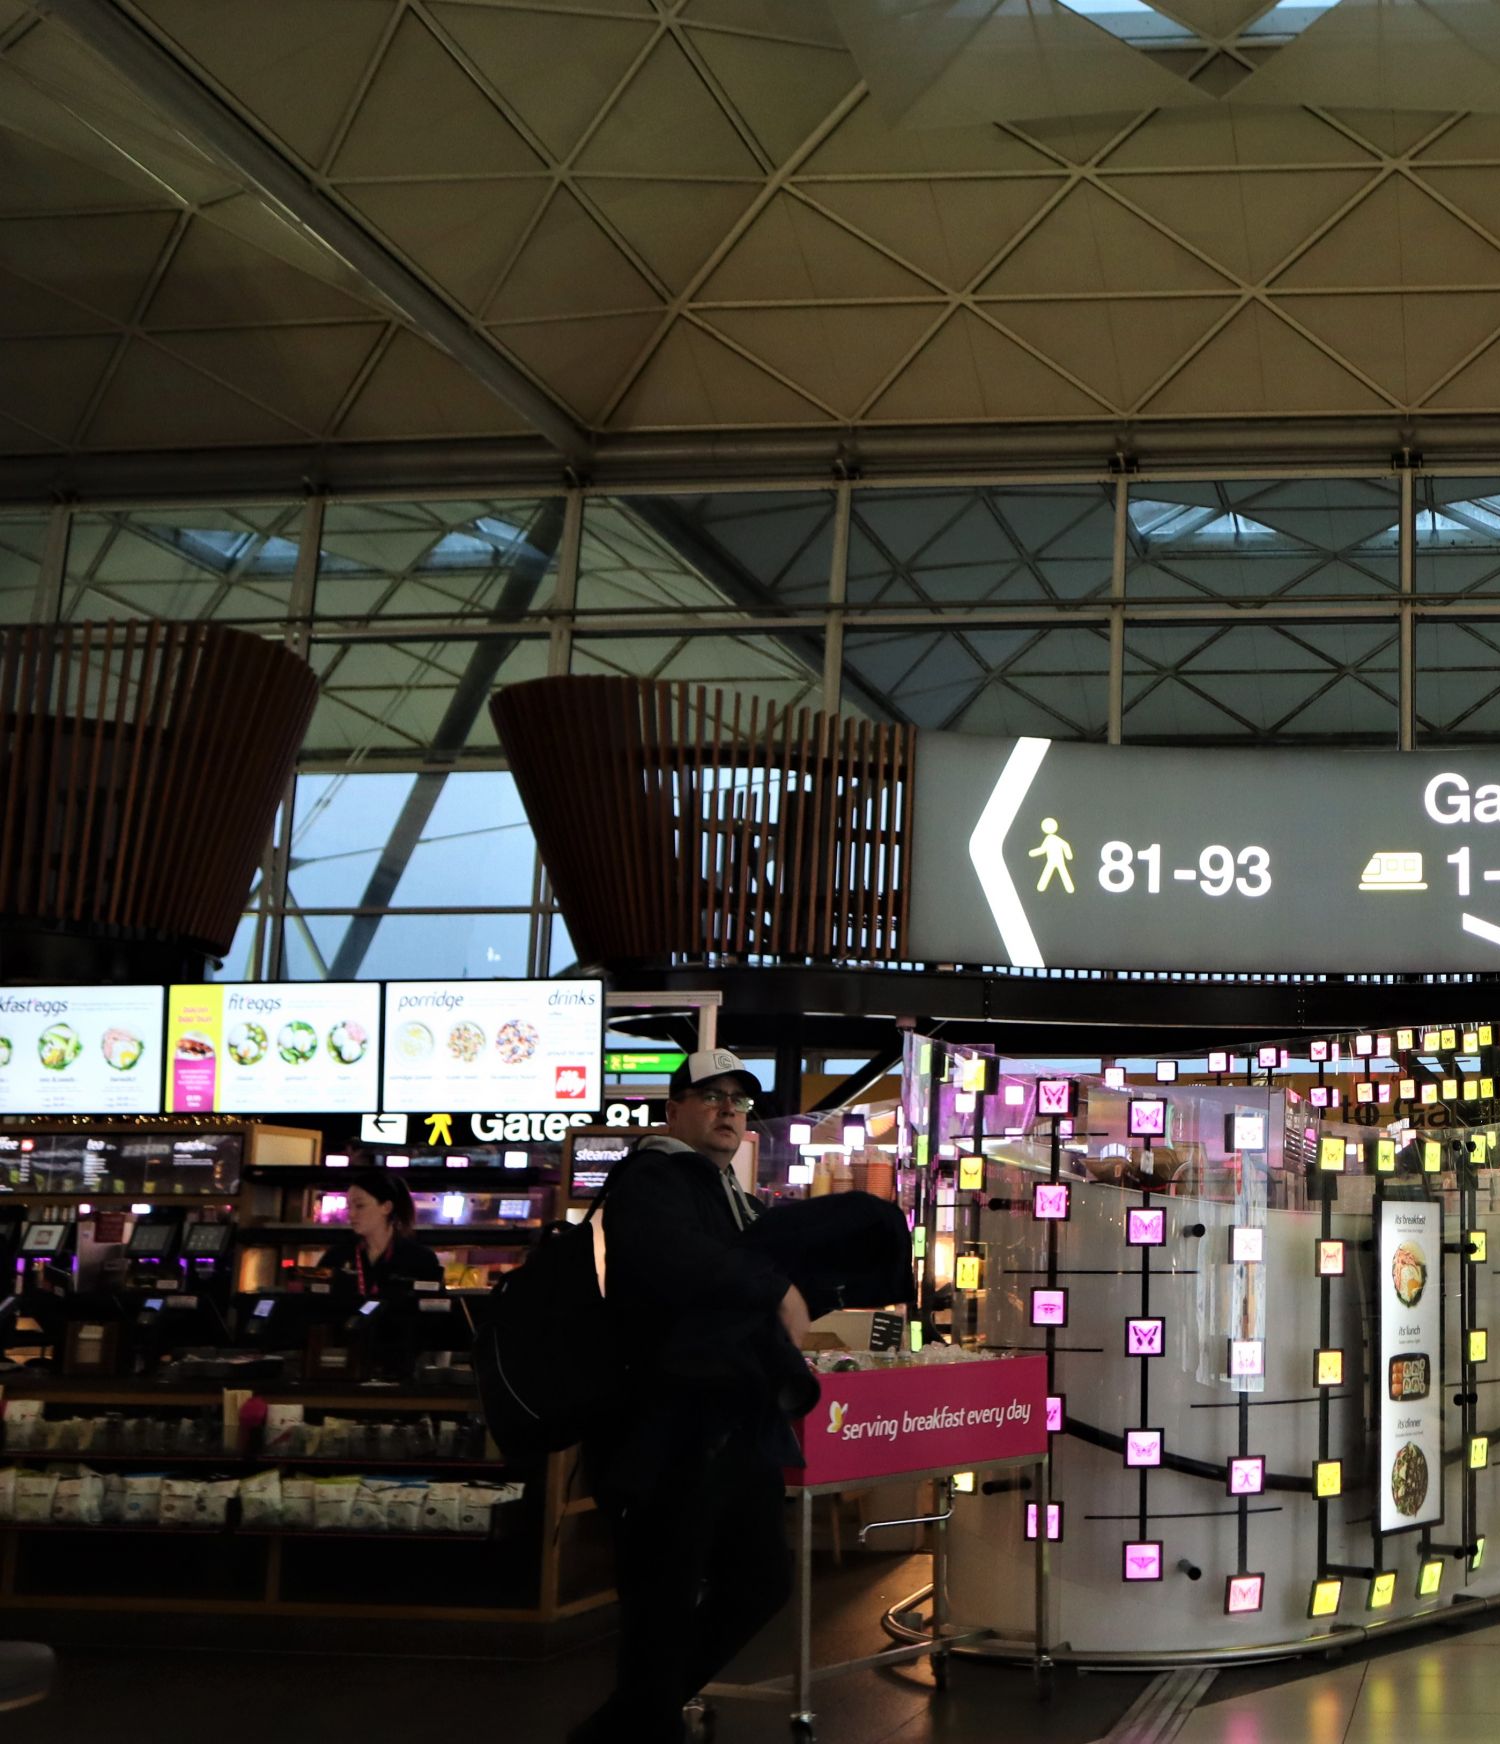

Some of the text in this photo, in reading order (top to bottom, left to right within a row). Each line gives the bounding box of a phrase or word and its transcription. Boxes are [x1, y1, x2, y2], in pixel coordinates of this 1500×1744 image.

[1098, 840, 1272, 898] 81-93
[398, 990, 464, 1012] porridge
[547, 988, 596, 1007] drinks
[842, 1398, 1032, 1442] serving breakfast every day
